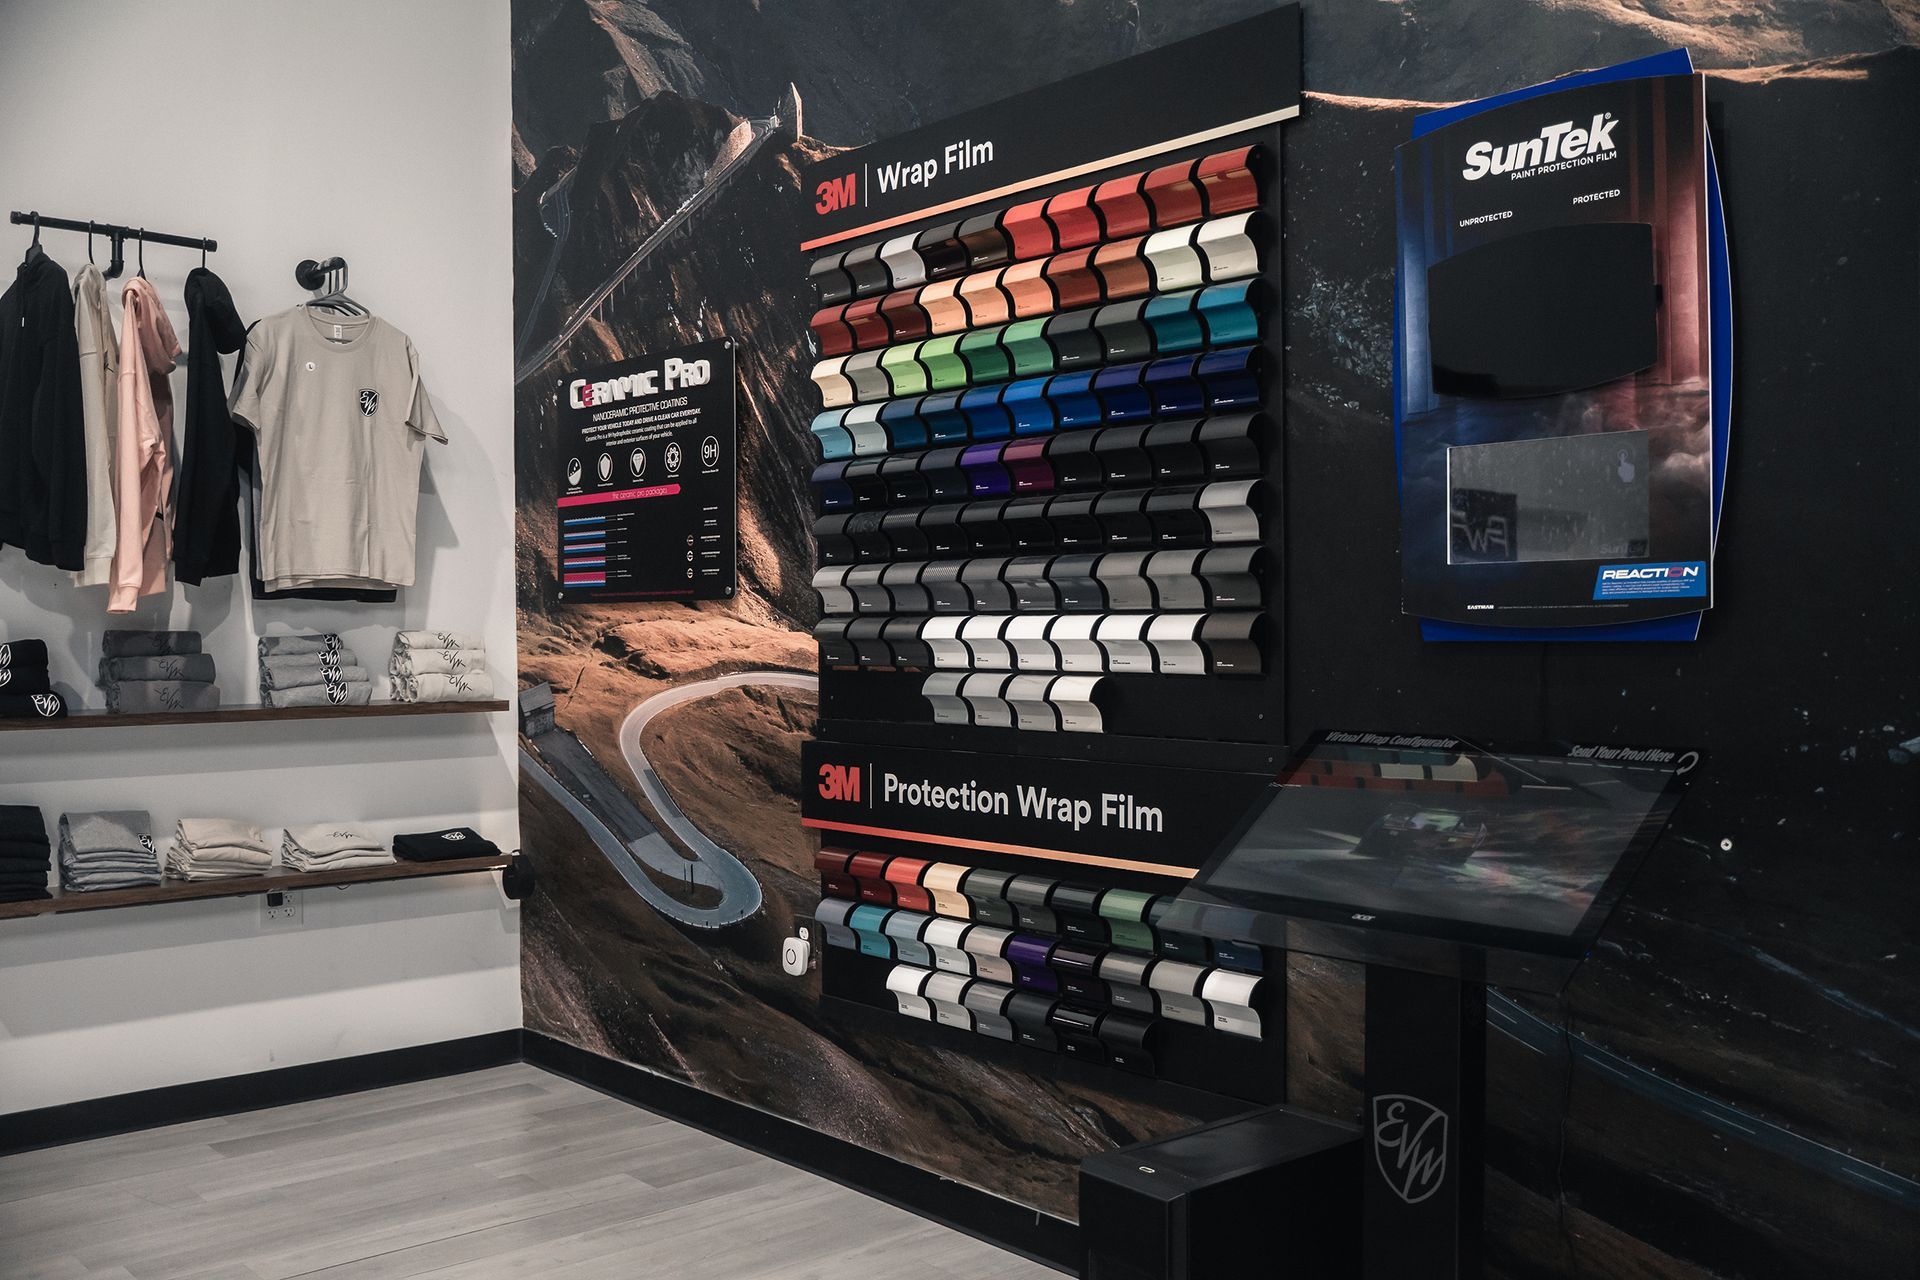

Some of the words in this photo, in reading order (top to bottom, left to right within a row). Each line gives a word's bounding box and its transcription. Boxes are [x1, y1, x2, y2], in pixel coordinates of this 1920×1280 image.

[1462, 113, 1619, 181] SunTek
[1511, 168, 1536, 180] PAINT
[1537, 155, 1594, 175] PROTECTION
[1596, 150, 1617, 163] FILM
[815, 172, 856, 215] 3M
[877, 158, 938, 194] Wrap
[944, 139, 994, 175] Film
[1572, 188, 1620, 205] PROTECTED
[1459, 210, 1513, 227] UNPROTECTED
[592, 407, 629, 422] NANOCERAMIC
[629, 402, 660, 417] PROTECTIVE
[660, 396, 688, 410] COATINGS
[581, 426, 597, 435] PROTECT
[597, 424, 607, 432] YOUR
[607, 422, 621, 430] VEHICLE
[622, 420, 634, 428] TODAY
[634, 418, 643, 426] AND
[657, 413, 670, 421] CLEAN
[670, 411, 679, 419] CAR
[704, 444, 717, 459] 9H
[1602, 566, 1699, 580] REACTION
[1325, 731, 1362, 743] Virtual
[1360, 732, 1391, 746] Wrap
[1389, 735, 1459, 748] Configurator
[1567, 744, 1599, 758] Send
[1595, 746, 1621, 759] Your
[1617, 747, 1652, 760] Proof
[1647, 748, 1675, 762] Here
[818, 763, 860, 802] 3M
[884, 773, 1009, 815] Protection
[1016, 784, 1092, 831] Wrap
[1102, 793, 1164, 832] Film
[1351, 913, 1377, 921] acer
